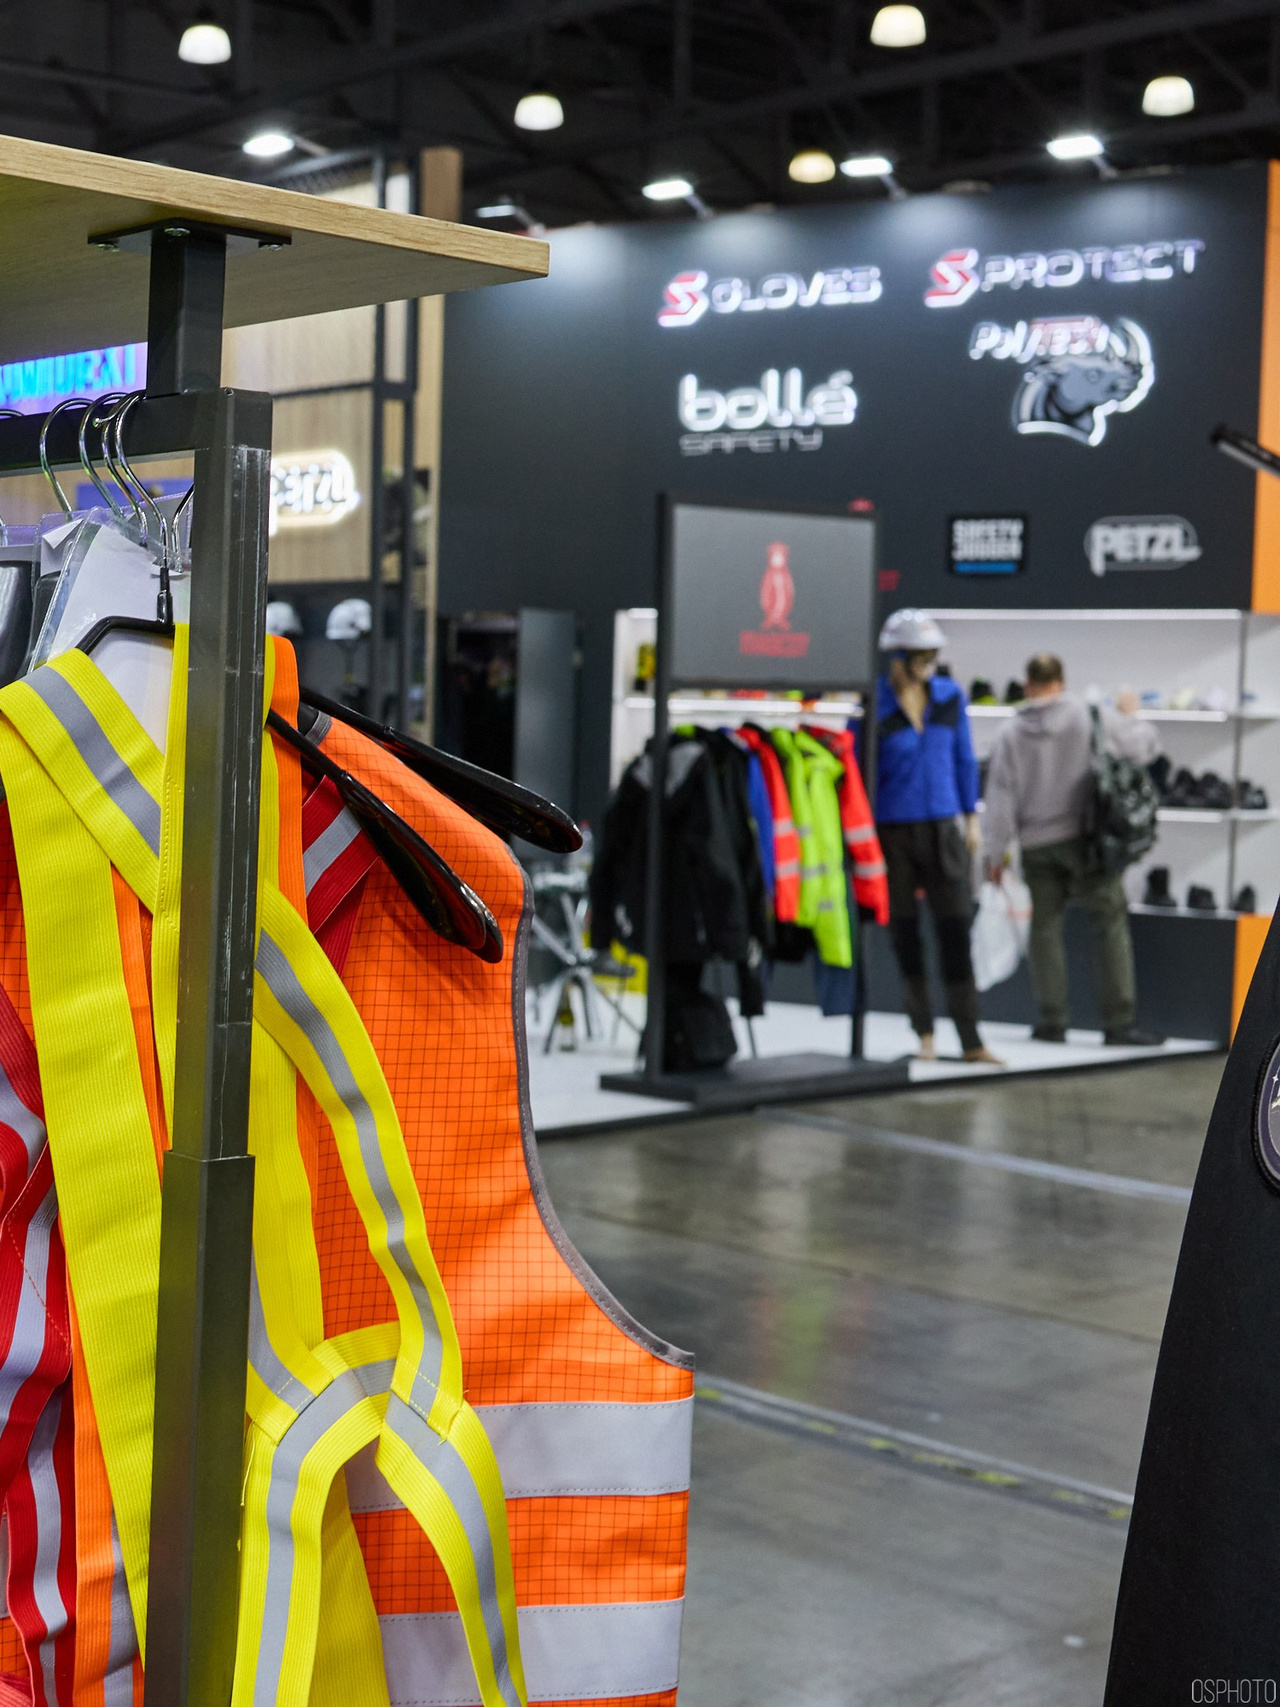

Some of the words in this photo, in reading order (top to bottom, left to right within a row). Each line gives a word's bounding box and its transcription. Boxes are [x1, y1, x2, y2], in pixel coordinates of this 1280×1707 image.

[679, 367, 857, 432] bollé
[679, 428, 823, 456] SAFETY
[1091, 522, 1202, 577] PETZL
